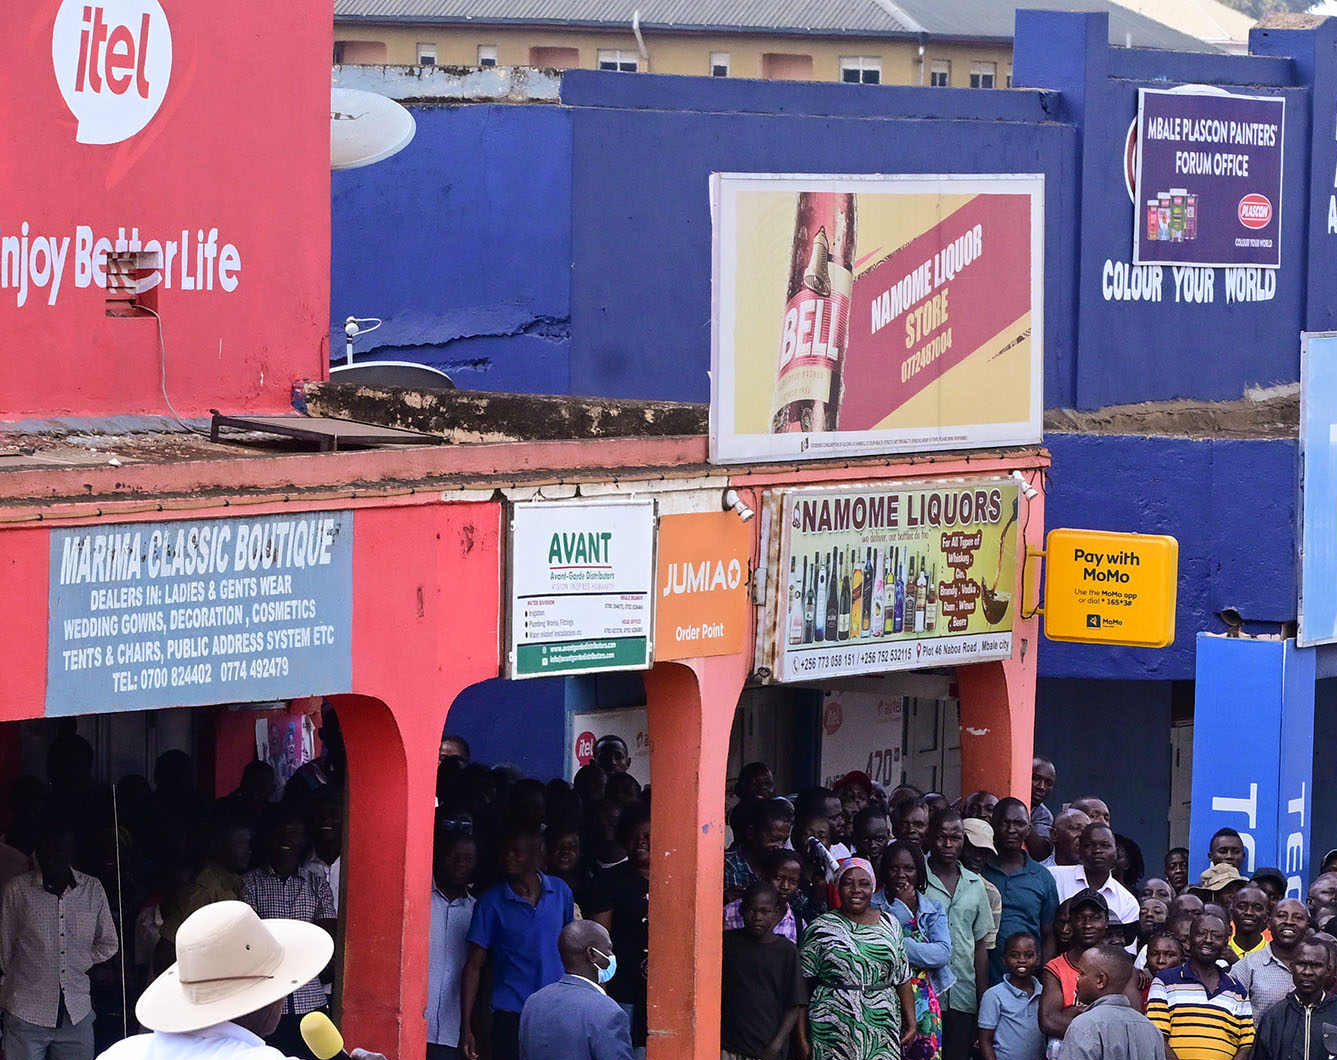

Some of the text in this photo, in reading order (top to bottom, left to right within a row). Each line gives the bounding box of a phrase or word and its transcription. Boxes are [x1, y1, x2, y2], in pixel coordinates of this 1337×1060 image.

[75, 5, 150, 100] itel
[1148, 117, 1228, 143] MBALE PLASCON
[1176, 152, 1248, 176] FORUM OFFICE
[1242, 206, 1268, 217] PLASCON
[75, 226, 241, 294] Better Life
[872, 224, 982, 334] NAMOME LIQUOR
[1103, 259, 1276, 304] COLOUR YOUR WORLD
[780, 299, 839, 371] BELL
[905, 288, 949, 349] STORE
[802, 489, 1001, 533] NAMOME LIQUORS
[60, 518, 335, 585] MARIMA CLASSIC BOUTIQUE
[549, 533, 612, 564] AVANT
[942, 537, 950, 547] For
[960, 536, 973, 549] Types
[1074, 549, 1140, 567] Pay with
[90, 575, 292, 611] DEALERS IN: LADIES & GENTS WEAR
[550, 571, 614, 580] Avant-Garde Distributors
[1083, 568, 1130, 583] MoMo
[1102, 590, 1122, 598] MoMo
[63, 599, 316, 640] WEDDING GOWNS, DECORATION COSMETICS
[675, 622, 724, 641] Order Point
[63, 625, 335, 672] TENTS & CHAIRS, PUBLIC ADDRESS SYSTEM ETC
[801, 656, 817, 671] +256
[818, 655, 829, 669] 773
[844, 653, 855, 667] 151
[860, 651, 876, 666] +256
[877, 650, 889, 664] 752
[890, 647, 912, 663] 532115
[922, 645, 934, 656] Plot
[935, 643, 942, 654] 46
[943, 642, 961, 654] Naboa
[962, 640, 977, 652] Road
[982, 637, 998, 650] Mbale
[999, 636, 1009, 651] city
[112, 657, 288, 693] TEL: 0700 824402 0774 492479
[579, 739, 593, 757] itel
